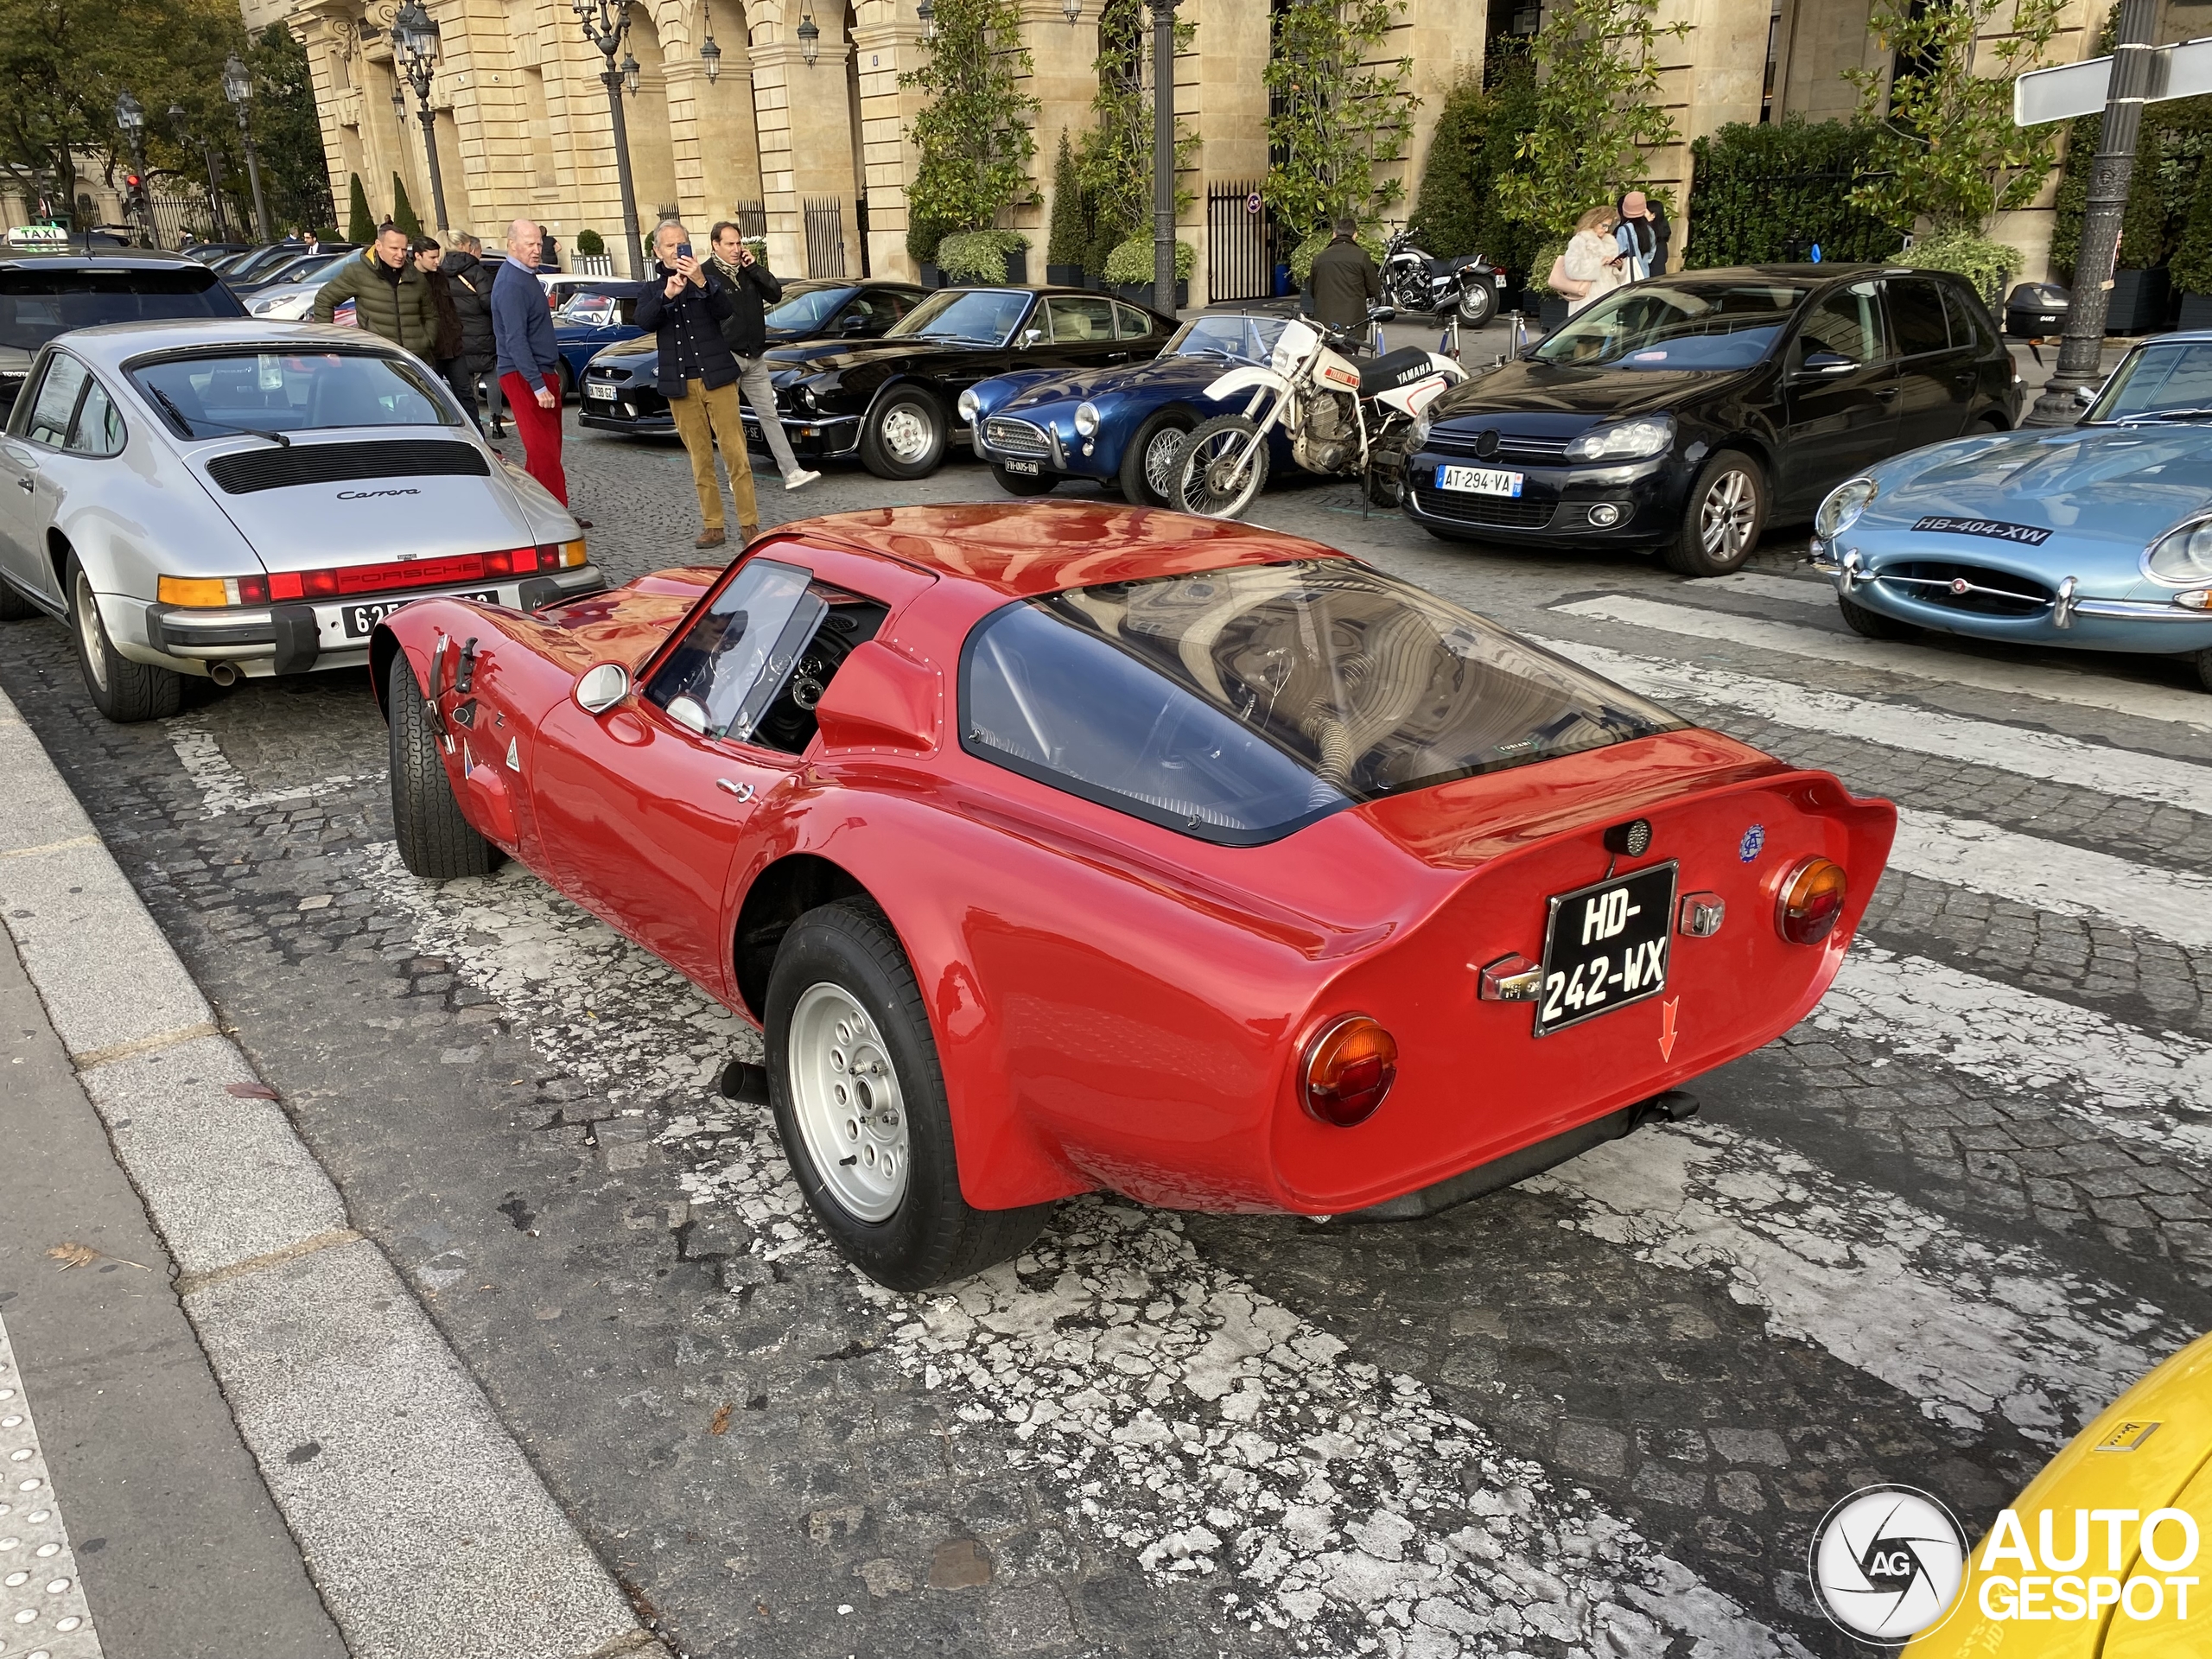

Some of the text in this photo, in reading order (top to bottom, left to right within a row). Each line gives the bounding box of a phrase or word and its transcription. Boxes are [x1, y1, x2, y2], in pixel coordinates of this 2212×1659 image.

[21, 229, 57, 238] TAXI
[1396, 361, 1431, 385] YAMAHA
[1445, 469, 1510, 493] AT-294-VA
[336, 488, 422, 500] Carrera
[1916, 518, 2048, 543] HB-404-XW
[340, 563, 482, 586] PORSCHE
[1581, 887, 1641, 946] HD-
[1541, 936, 1666, 1023] 242-WX
